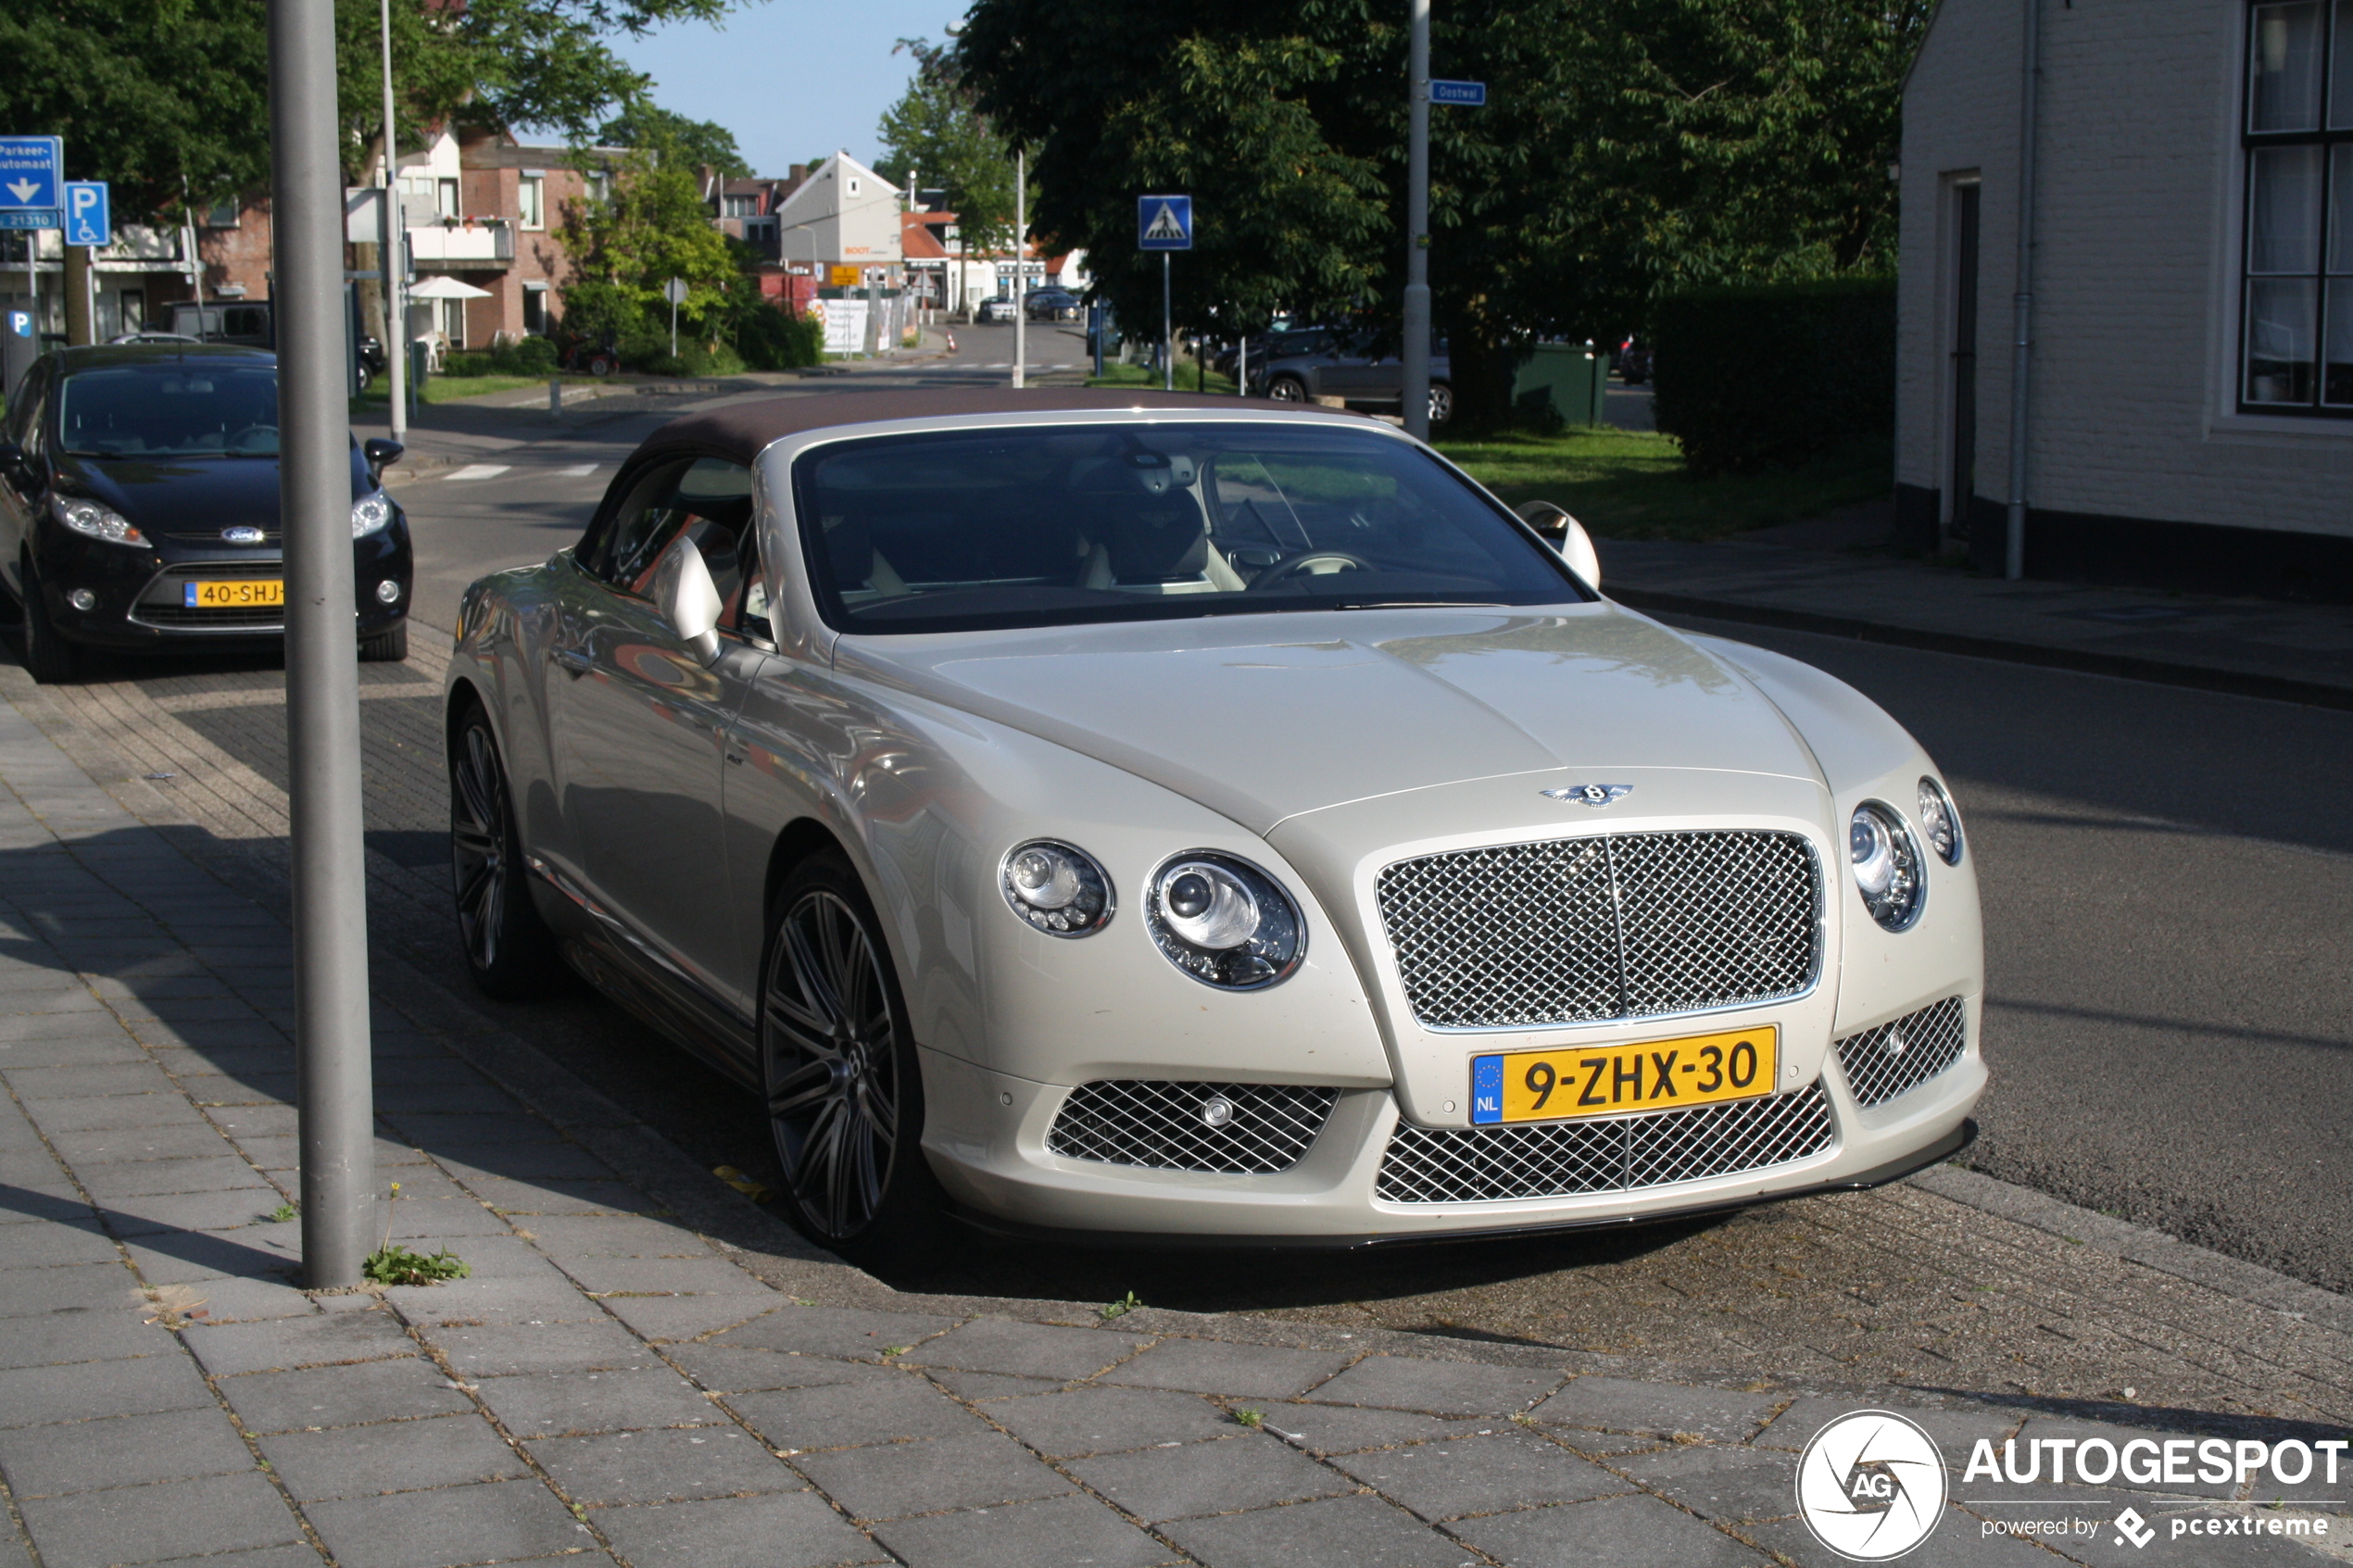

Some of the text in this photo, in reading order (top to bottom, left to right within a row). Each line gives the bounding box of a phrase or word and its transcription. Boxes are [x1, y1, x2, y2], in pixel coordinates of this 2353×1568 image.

[1439, 86, 1478, 99] Oostwal
[0, 159, 52, 169] utomaat
[73, 187, 97, 219] P
[10, 215, 50, 226] 21310
[845, 246, 870, 255] BOOT
[14, 312, 29, 333] P
[230, 529, 255, 540] Ford
[1583, 786, 1605, 800] B
[1525, 1041, 1757, 1110] 9-ZHX-30
[1477, 1098, 1499, 1111] NL
